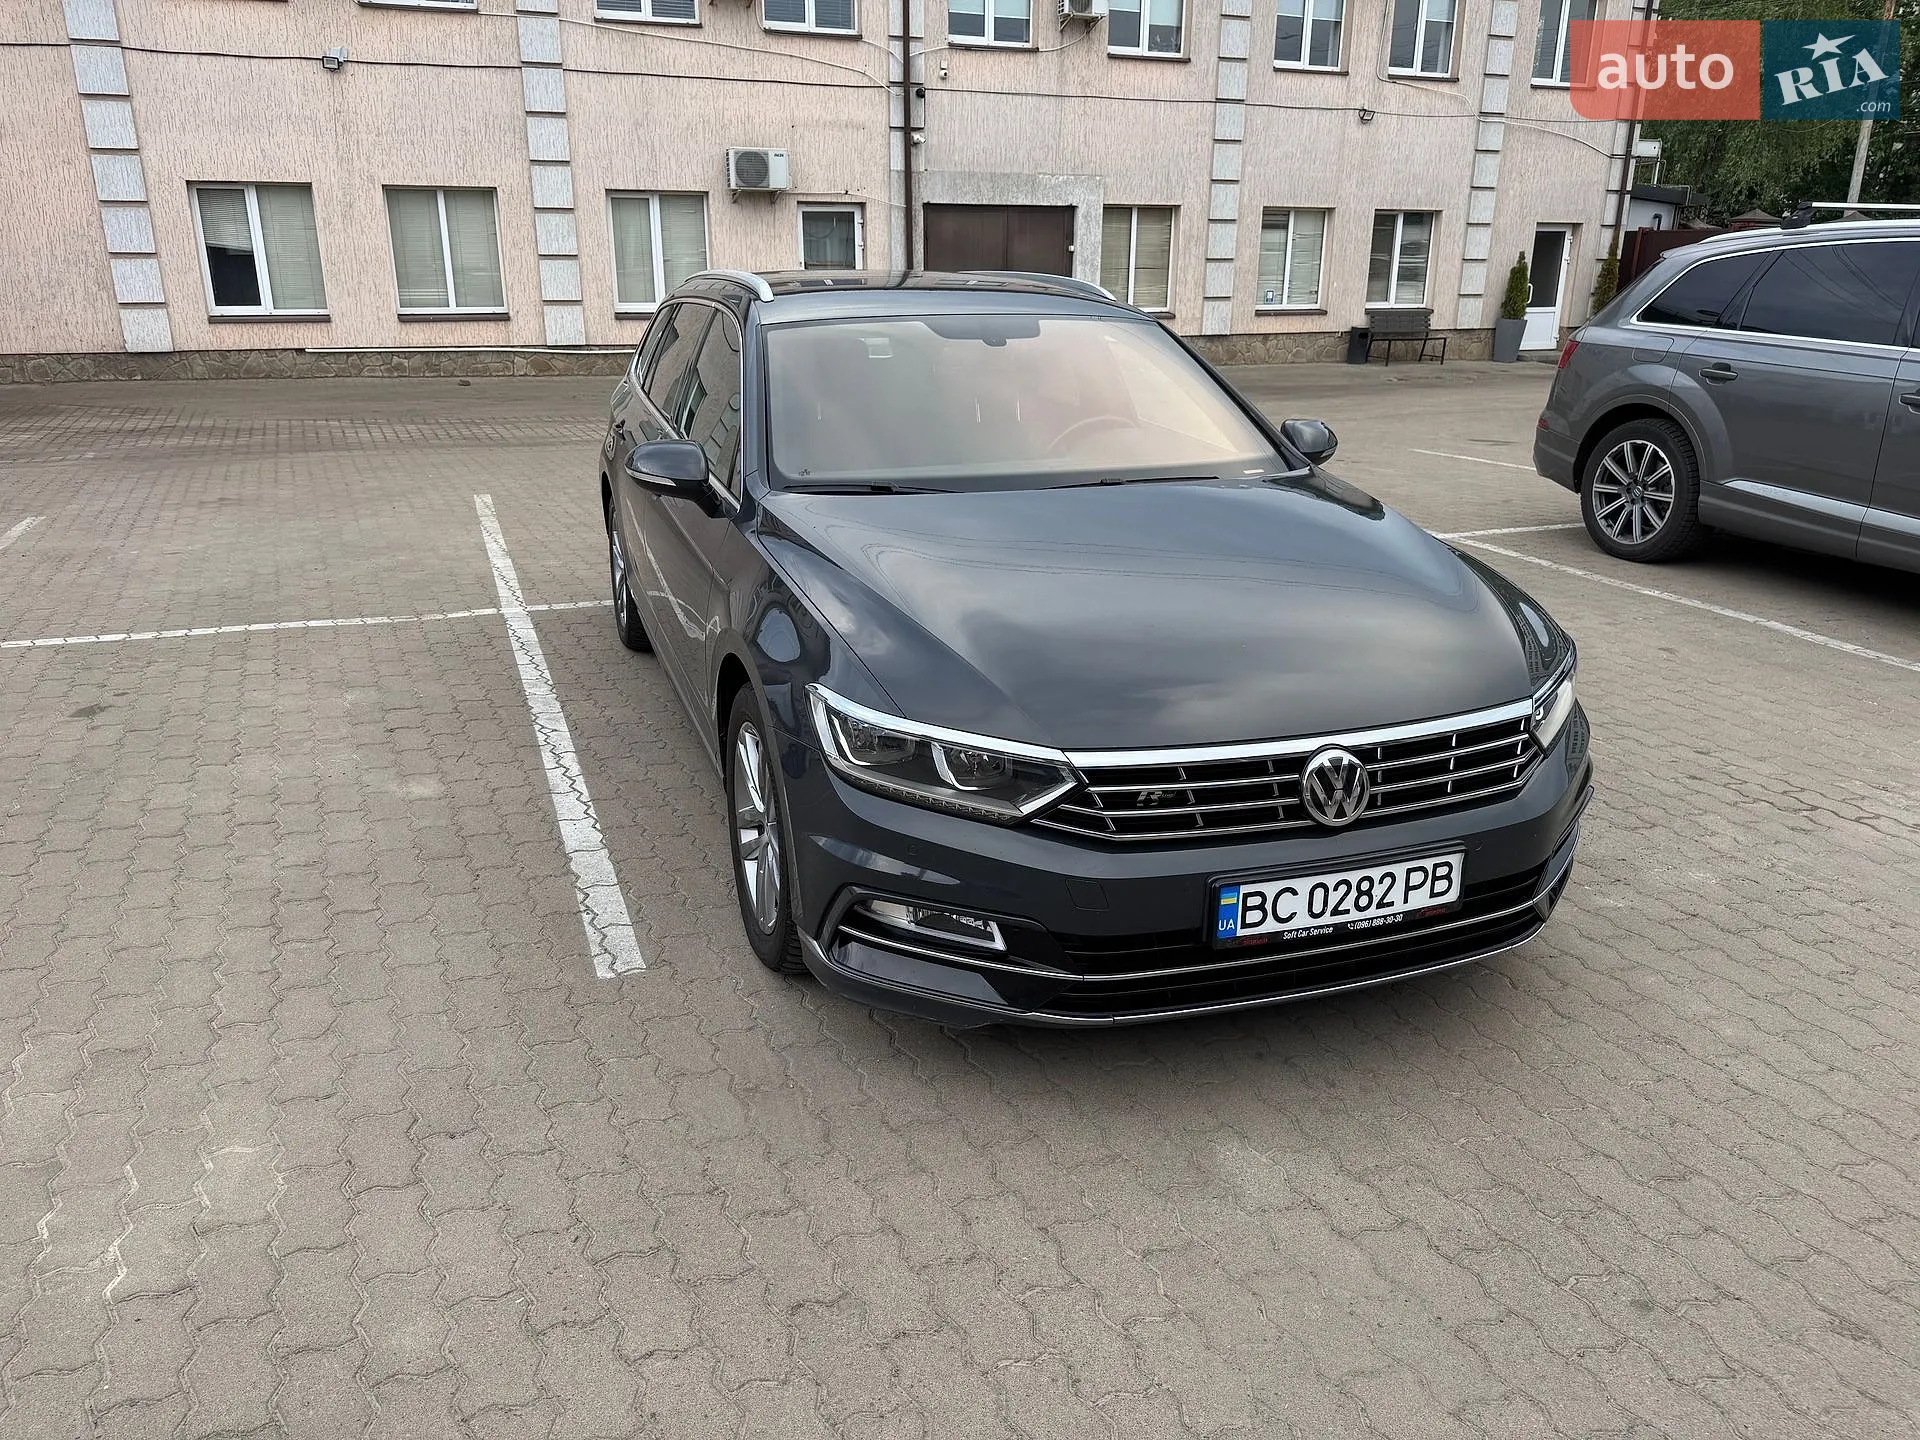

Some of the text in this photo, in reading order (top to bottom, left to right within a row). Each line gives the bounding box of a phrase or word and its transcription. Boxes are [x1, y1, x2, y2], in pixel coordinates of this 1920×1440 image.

[1240, 861, 1454, 929] BC 0282 PB
[1218, 919, 1235, 931] UA
[1283, 926, 1334, 940] Soft Car Service
